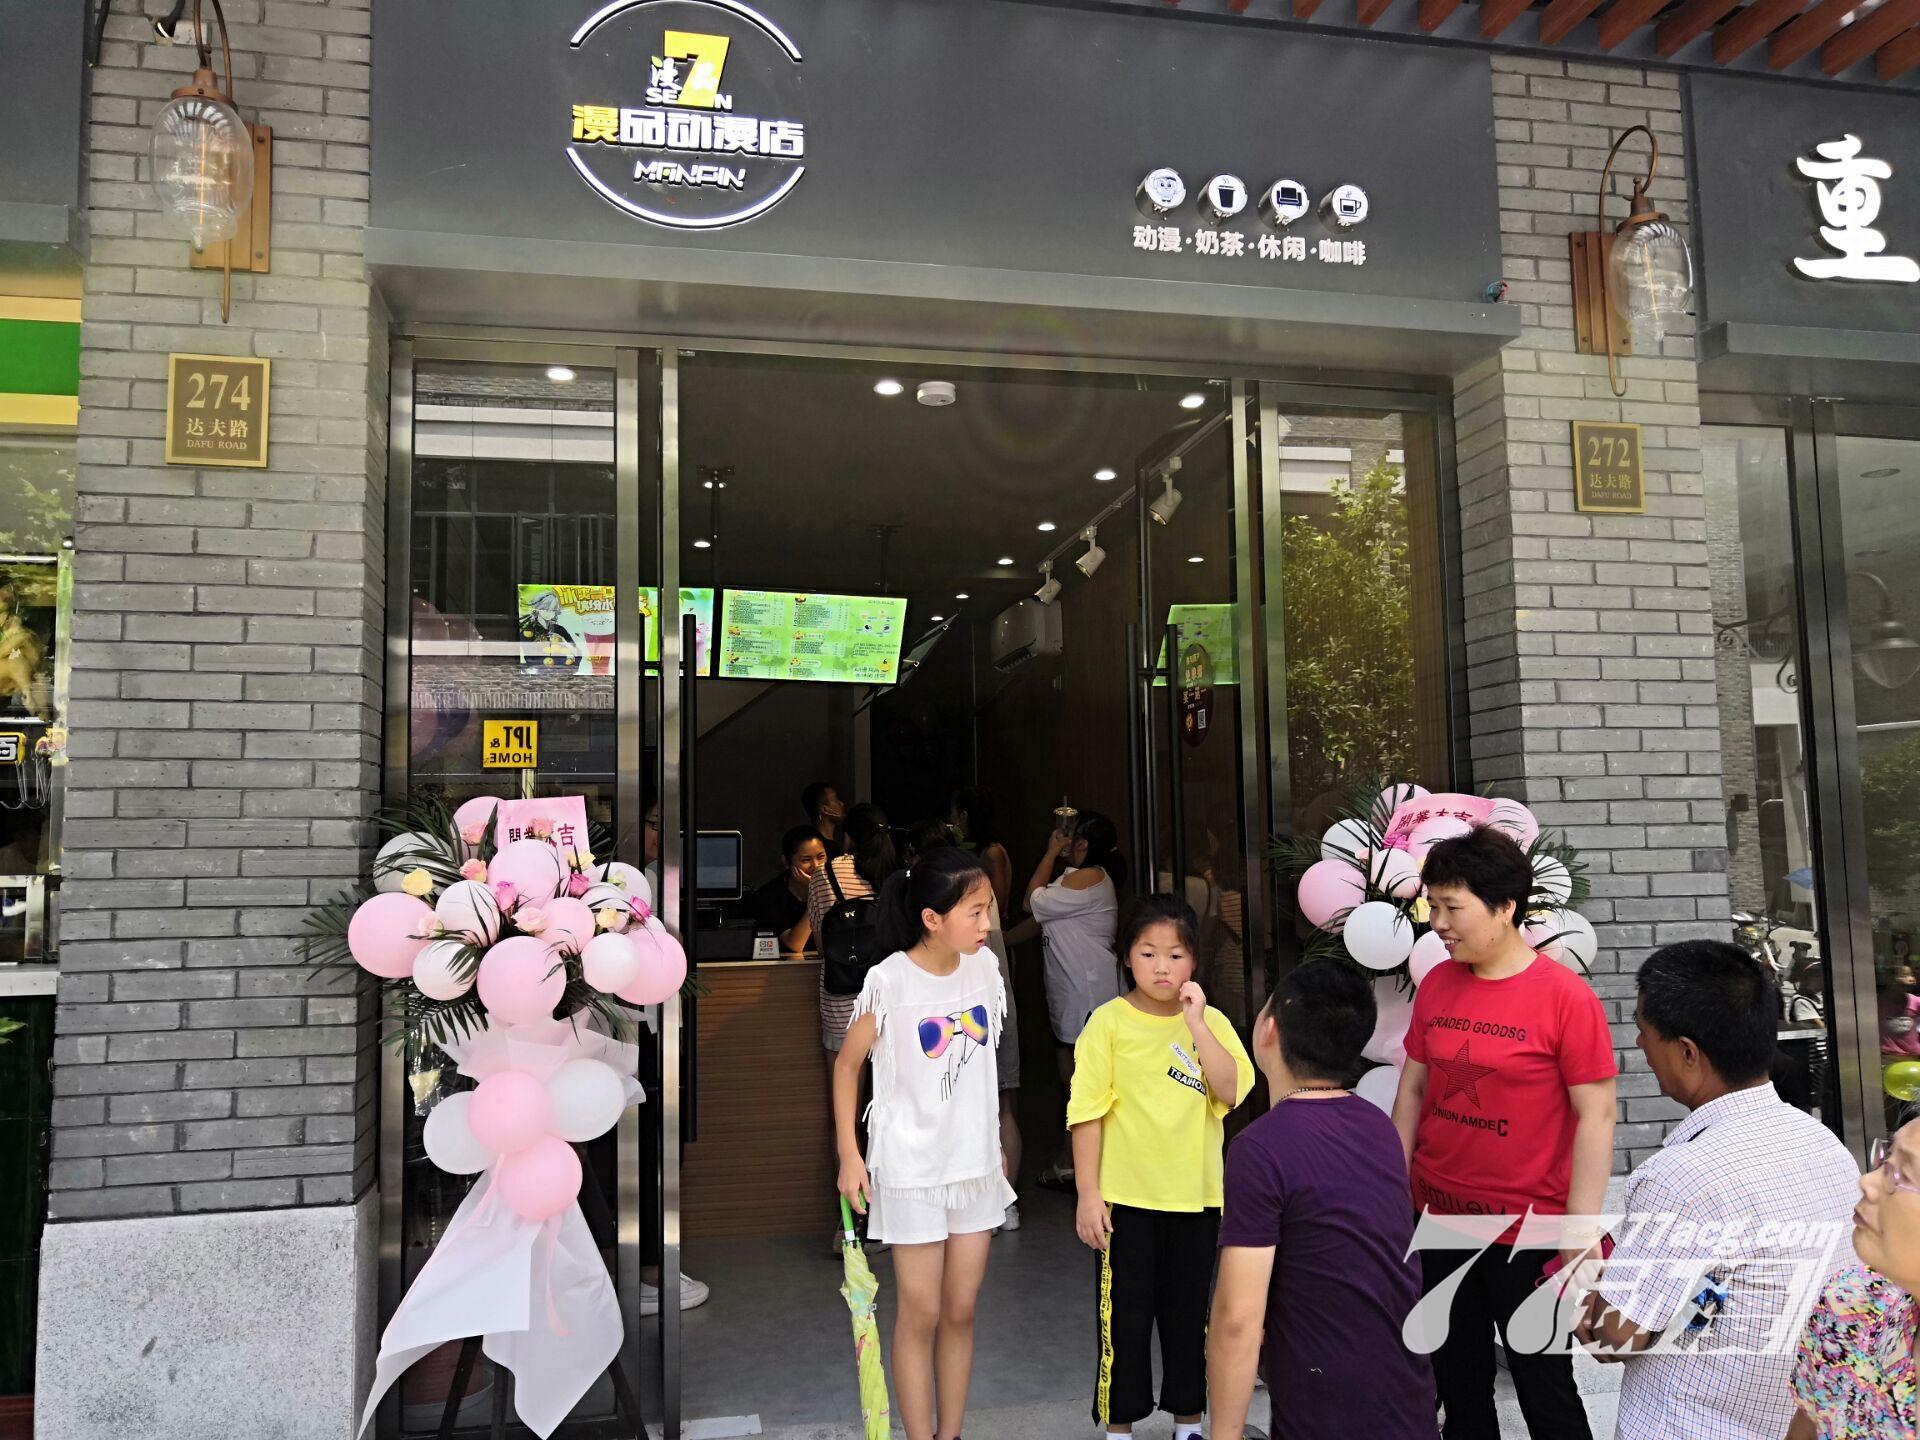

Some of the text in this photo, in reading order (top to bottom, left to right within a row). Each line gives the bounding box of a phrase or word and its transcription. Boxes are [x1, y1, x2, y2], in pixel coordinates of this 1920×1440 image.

[572, 104, 805, 157] 漫品动漫店
[1793, 133, 1920, 283] 重
[186, 372, 251, 411] 274
[186, 417, 248, 438] 达夫路
[187, 439, 247, 450] DAFU ROAD
[1588, 436, 1631, 467] 272
